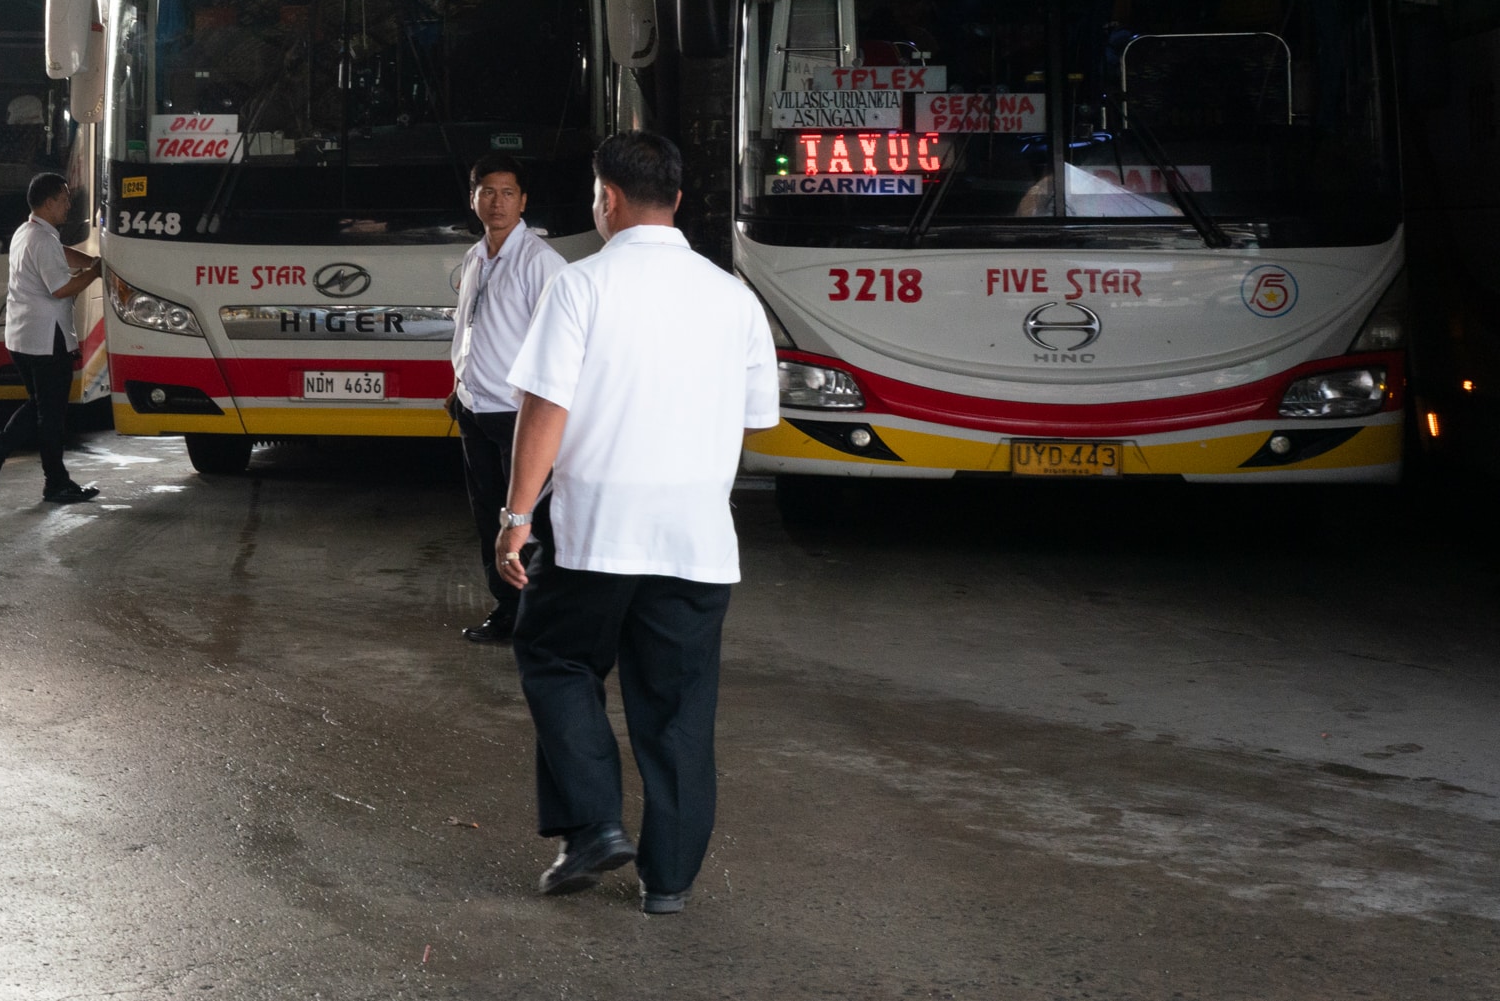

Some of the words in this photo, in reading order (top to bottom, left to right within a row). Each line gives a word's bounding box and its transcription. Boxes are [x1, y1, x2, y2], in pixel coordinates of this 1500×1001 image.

[831, 67, 928, 90] TPLEX
[930, 95, 1035, 115] GERONA
[169, 117, 214, 132] DAU
[792, 109, 867, 127] ASINGAN
[155, 138, 229, 158] TARLAC
[800, 178, 915, 194] CARMEN
[118, 211, 182, 236] 3448
[196, 265, 240, 287] FIVE
[250, 265, 307, 290] STAR
[828, 268, 924, 304] 3218
[986, 268, 1048, 297] FIVE
[1064, 268, 1143, 300] STAR
[280, 312, 406, 333] HIGER
[1033, 353, 1096, 364] HINO
[306, 378, 334, 393] NDM
[344, 378, 382, 393] 4636
